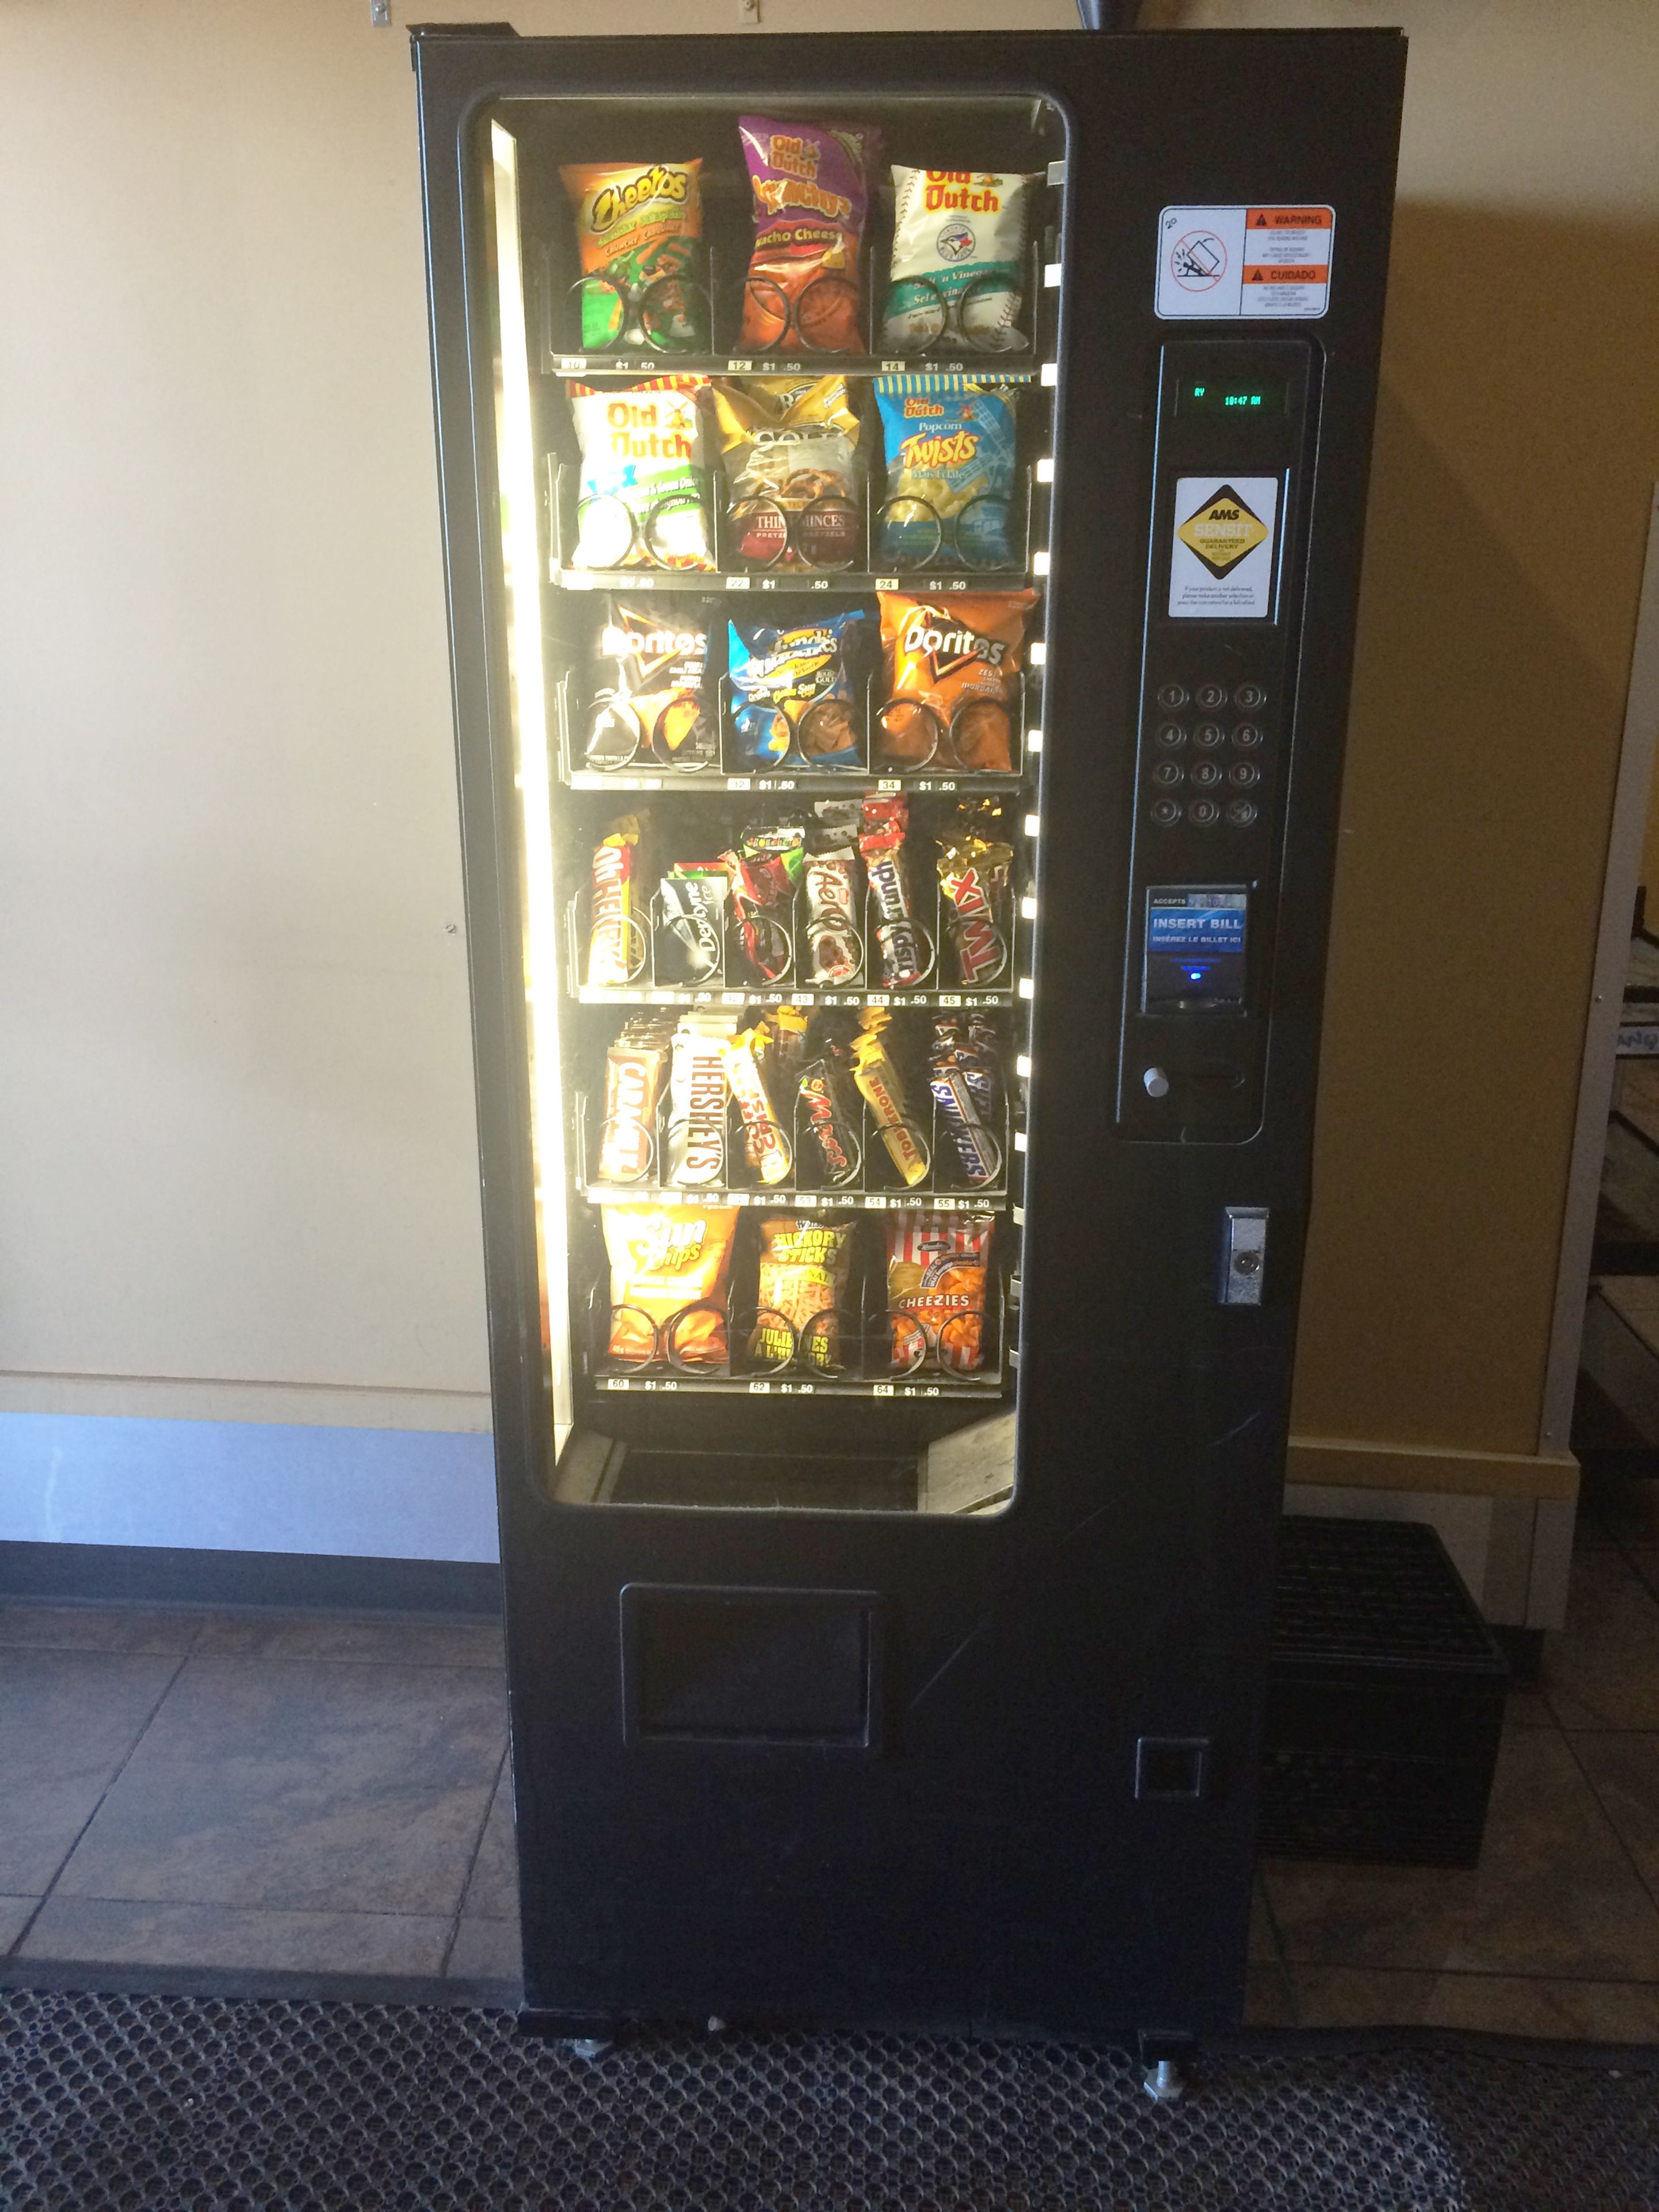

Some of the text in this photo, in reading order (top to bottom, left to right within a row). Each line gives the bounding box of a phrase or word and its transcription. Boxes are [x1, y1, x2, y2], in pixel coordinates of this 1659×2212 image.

[771, 135, 803, 154] Old
[771, 151, 817, 180] Dutch
[591, 164, 688, 232] Cheetos
[926, 184, 999, 213] Dutch
[1274, 215, 1322, 225] WARNING
[1271, 270, 1316, 280] CUIDADO
[733, 362, 747, 370] 12
[762, 362, 776, 371] $1
[886, 363, 900, 371] 14
[925, 362, 964, 372] $1 .50
[608, 402, 657, 427] Old
[904, 404, 944, 418] Dutch
[919, 422, 963, 432] Popcorn
[611, 431, 691, 458] Dutch
[900, 430, 981, 469] Twists
[1209, 509, 1240, 521] AMS
[1194, 522, 1253, 537] SENSIT
[762, 579, 828, 589] $1 .50
[879, 580, 893, 589] 24
[929, 579, 967, 590] $1 .50
[904, 626, 1005, 665] Doritos
[1168, 690, 1175, 703] 1
[1207, 690, 1214, 703] 2
[1245, 690, 1253, 703] 3
[1166, 729, 1173, 741] 4
[1205, 729, 1212, 741] 5
[1243, 729, 1251, 741] 6
[1164, 767, 1172, 779] 7
[1202, 767, 1209, 779] 8
[1240, 767, 1247, 779] 9
[759, 779, 795, 790] $1 .50
[882, 781, 895, 789] 34
[919, 781, 956, 791] $1 .50
[1199, 805, 1207, 817] 0
[593, 846, 624, 883] Oh
[701, 885, 715, 905] Ice
[809, 870, 850, 931] Aero
[950, 866, 1002, 982] TWIX
[1153, 918, 1242, 929] INSERT BILL
[1153, 934, 1186, 942] INSÉREZ
[748, 994, 782, 1005] $1 .50
[796, 995, 809, 1003] 43
[824, 995, 860, 1005] $1 .50
[871, 996, 884, 1004] 44
[893, 995, 927, 1006] $1 .50
[943, 997, 956, 1005] 45
[965, 995, 999, 1006] $1 .50
[686, 1056, 725, 1169] HERSHEY'S
[753, 1194, 786, 1206] $1 .50
[821, 1196, 854, 1207] $1 .50
[869, 1198, 881, 1206] 54
[889, 1197, 922, 1208] $1 .50
[938, 1199, 950, 1207] 55
[957, 1199, 990, 1209] $1 .50
[773, 1229, 847, 1249] HICKORY
[778, 1245, 838, 1265] STICKS
[898, 1295, 969, 1309] CHEEZIES
[612, 1380, 624, 1388] 60
[645, 1381, 677, 1391] $1 .50
[753, 1382, 765, 1391] 62
[781, 1384, 813, 1393] $1 .50
[877, 1385, 889, 1393] 64
[904, 1387, 939, 1396] $1 .50
